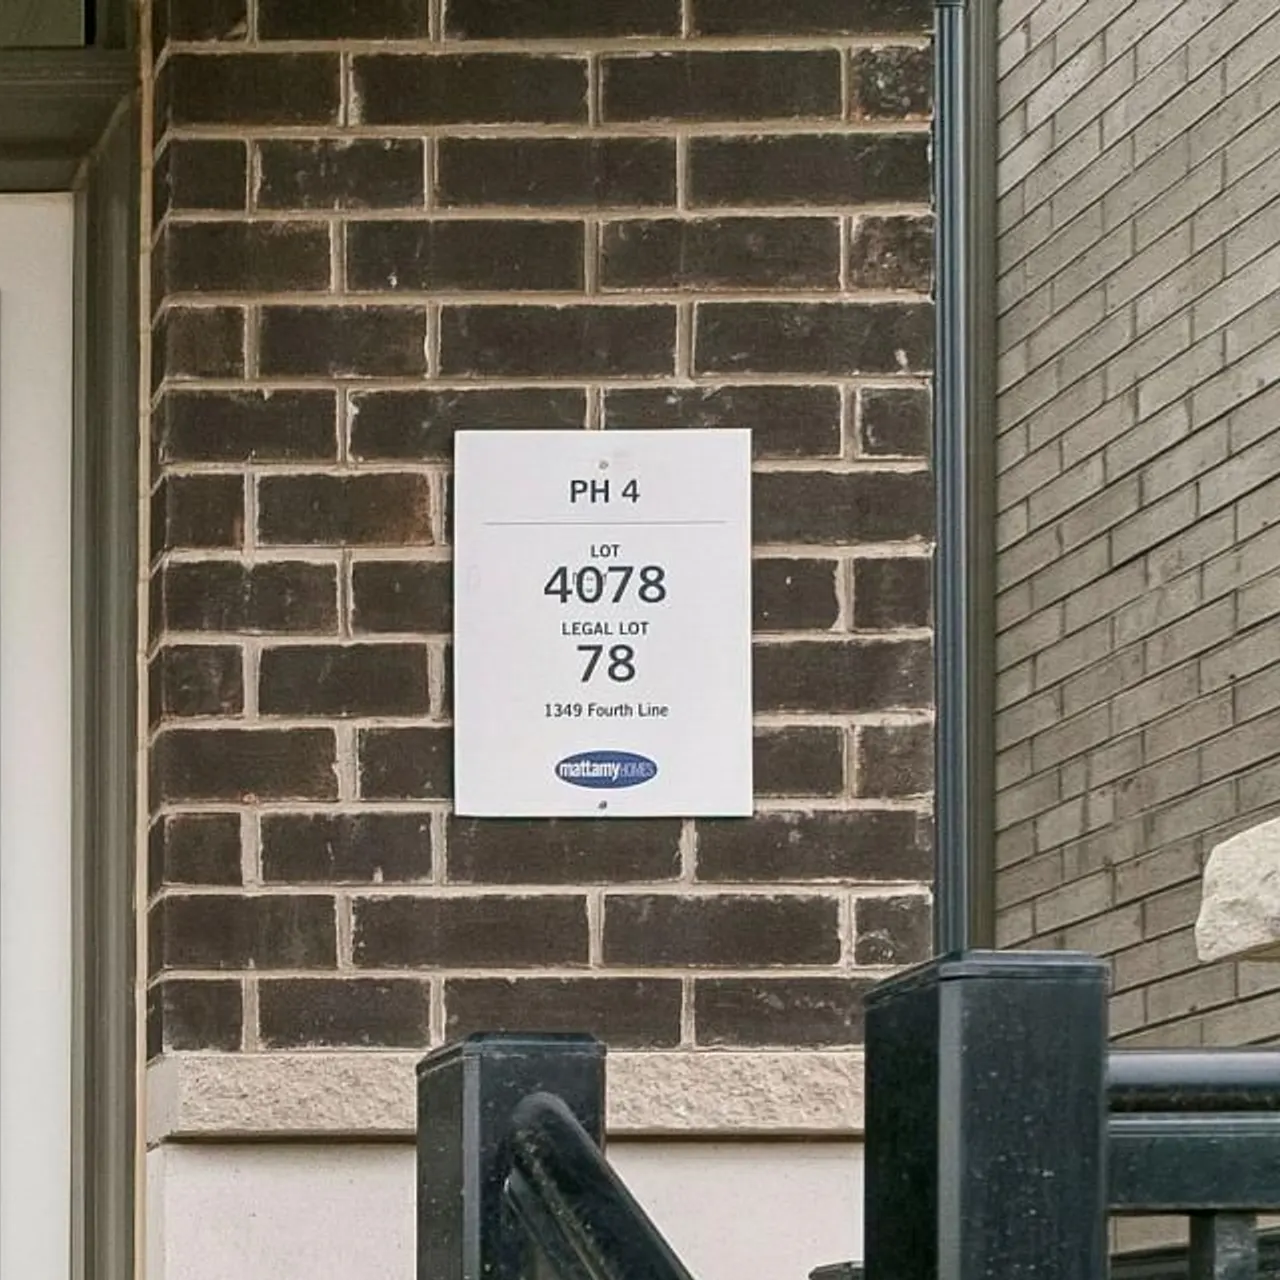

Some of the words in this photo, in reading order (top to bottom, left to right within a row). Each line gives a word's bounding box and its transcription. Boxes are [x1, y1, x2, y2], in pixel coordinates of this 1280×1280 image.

[570, 479, 610, 504] PH
[621, 479, 641, 504] 4
[590, 544, 620, 558] LOT
[543, 565, 667, 604] 4078
[562, 622, 614, 636] LEGAL
[619, 622, 650, 636] LOT
[576, 643, 636, 683] 78
[545, 703, 583, 718] 1349
[587, 702, 634, 718] Fourth
[638, 703, 670, 718] Line
